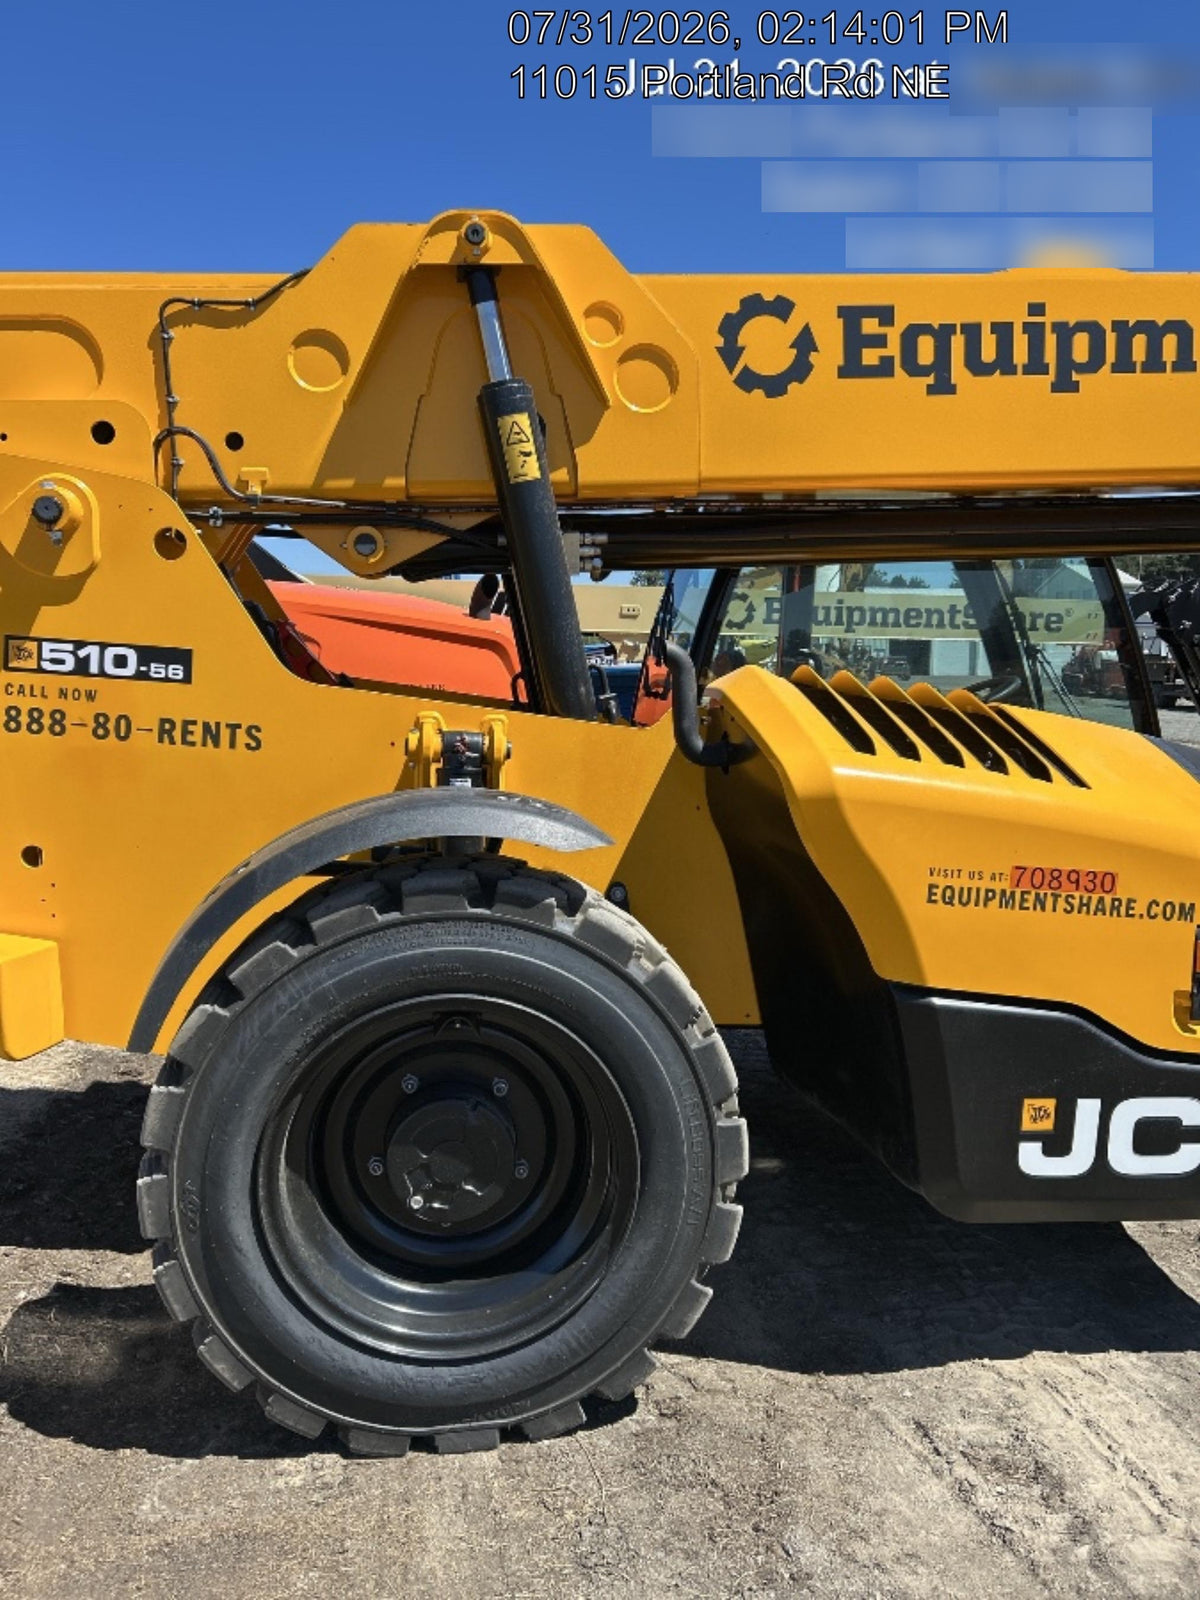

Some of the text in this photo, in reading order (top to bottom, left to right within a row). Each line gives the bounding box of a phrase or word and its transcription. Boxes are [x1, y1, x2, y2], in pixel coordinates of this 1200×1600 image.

[837, 302, 1197, 395] Equipm
[40, 641, 184, 680] 510-56
[4, 682, 97, 702] CALL NOW
[3, 705, 262, 751] 888-80-RENTS
[928, 867, 1009, 883] VISIT US AT:
[1014, 866, 1116, 893] 708930
[927, 883, 1196, 923] EQUIPMENTSHARE.COM
[1018, 1097, 1200, 1178] JC
